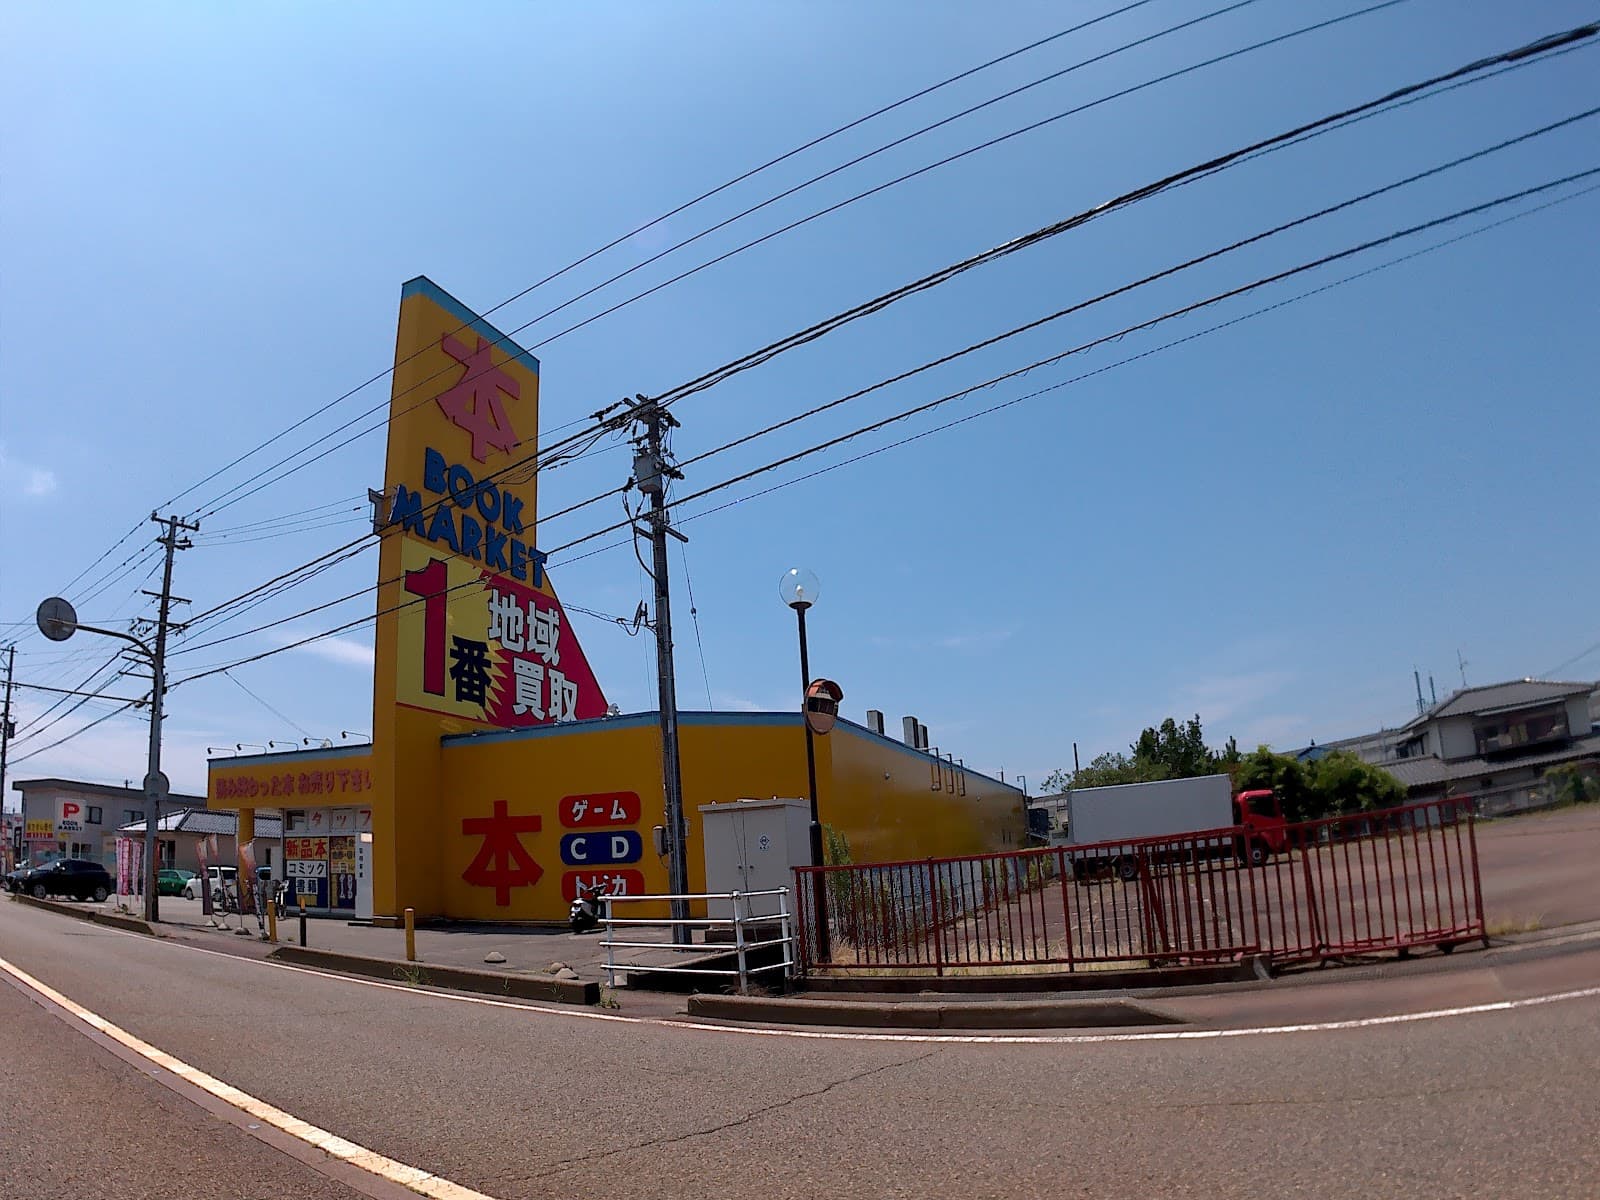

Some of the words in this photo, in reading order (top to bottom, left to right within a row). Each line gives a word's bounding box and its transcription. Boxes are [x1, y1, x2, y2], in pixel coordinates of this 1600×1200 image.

[436, 332, 520, 464] 本
[424, 447, 524, 534] BOOK
[389, 484, 547, 588] MARKET
[487, 588, 560, 666] 地域
[513, 657, 578, 721] 買取
[63, 803, 80, 818] P
[572, 799, 627, 822] ゲーム
[287, 839, 326, 858] 新品本
[288, 862, 325, 875] コミック
[462, 800, 544, 906] 本
[570, 836, 630, 860] CD
